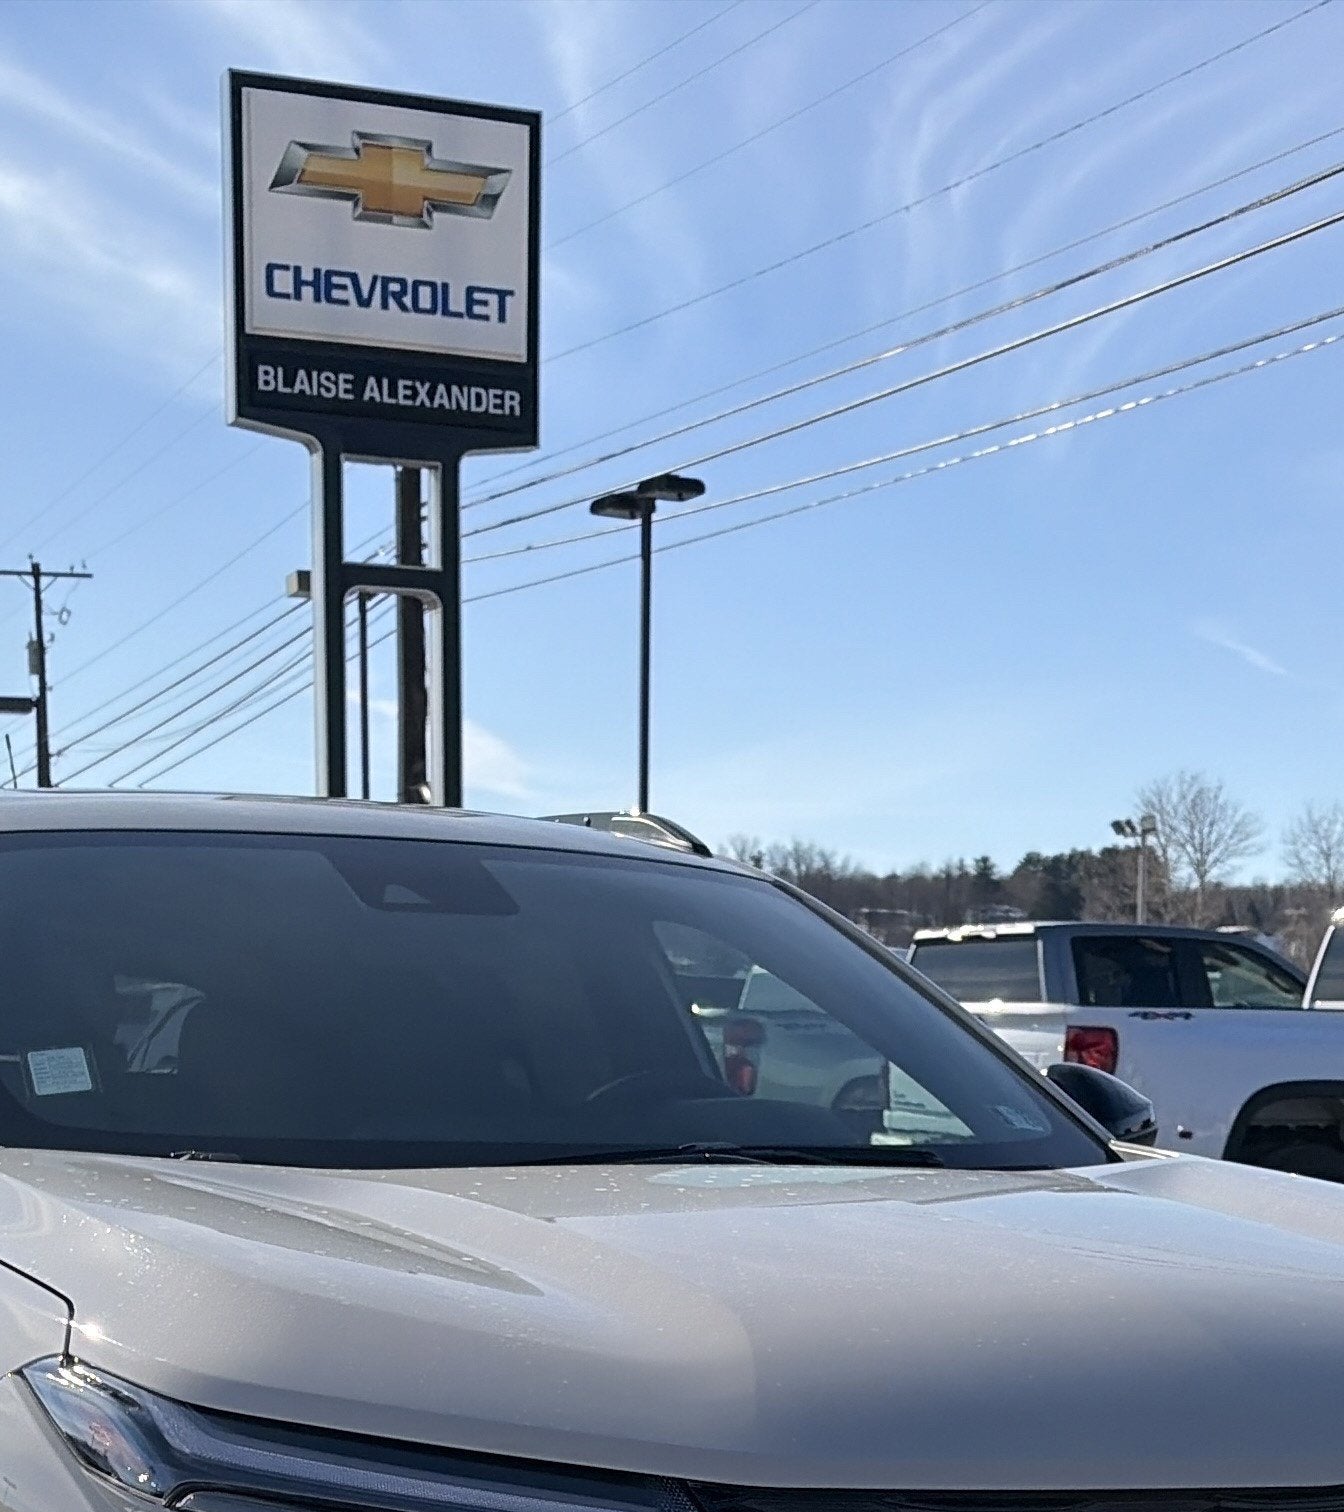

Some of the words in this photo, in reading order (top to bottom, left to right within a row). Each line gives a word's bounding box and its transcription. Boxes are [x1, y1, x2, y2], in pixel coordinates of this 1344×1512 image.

[265, 262, 515, 324] CHEVROLET
[257, 364, 354, 400] BLAISE
[363, 376, 521, 416] ALEXANDER
